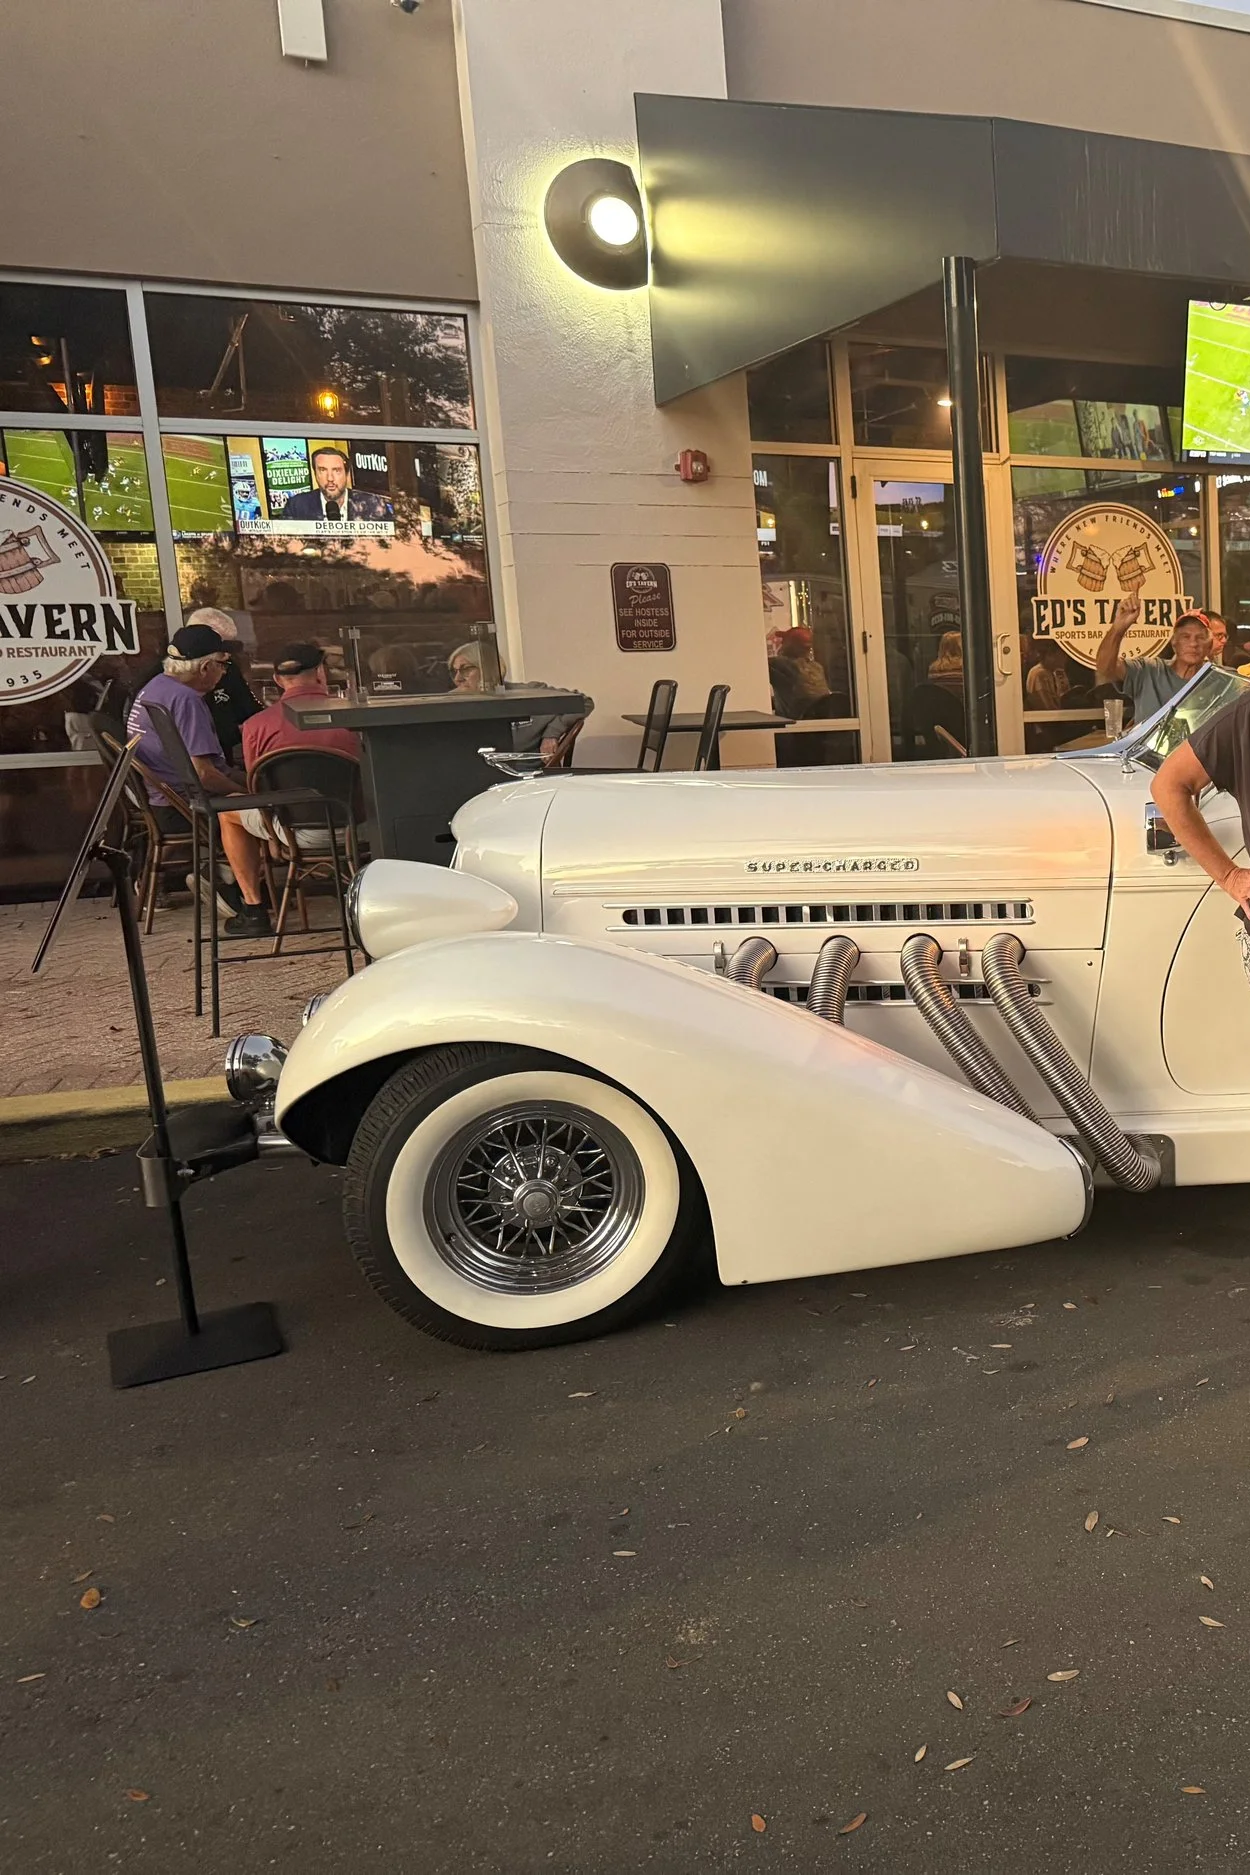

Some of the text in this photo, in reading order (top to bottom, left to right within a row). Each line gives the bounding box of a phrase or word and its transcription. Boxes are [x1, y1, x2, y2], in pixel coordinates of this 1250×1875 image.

[267, 468, 310, 479] DIXIELAND
[272, 475, 306, 486] DELIGHT
[315, 521, 389, 531] DEBOER DONE
[57, 528, 91, 571] MEET
[1050, 515, 1171, 574] WHERE NEW FRIENDS MEET
[629, 592, 661, 608] Please
[619, 607, 669, 617] SEE HOSTESS
[1035, 598, 1192, 636] ED'S TERN
[634, 618, 659, 627] INSIDE
[621, 629, 671, 638] FOR OUTSIDE
[1055, 630, 1086, 640] SPORTS
[1087, 630, 1103, 639] BAR
[633, 639, 664, 649] SERVICE
[7, 645, 97, 659] RESTAURANT
[747, 859, 917, 873] SUPER-CHARGED
